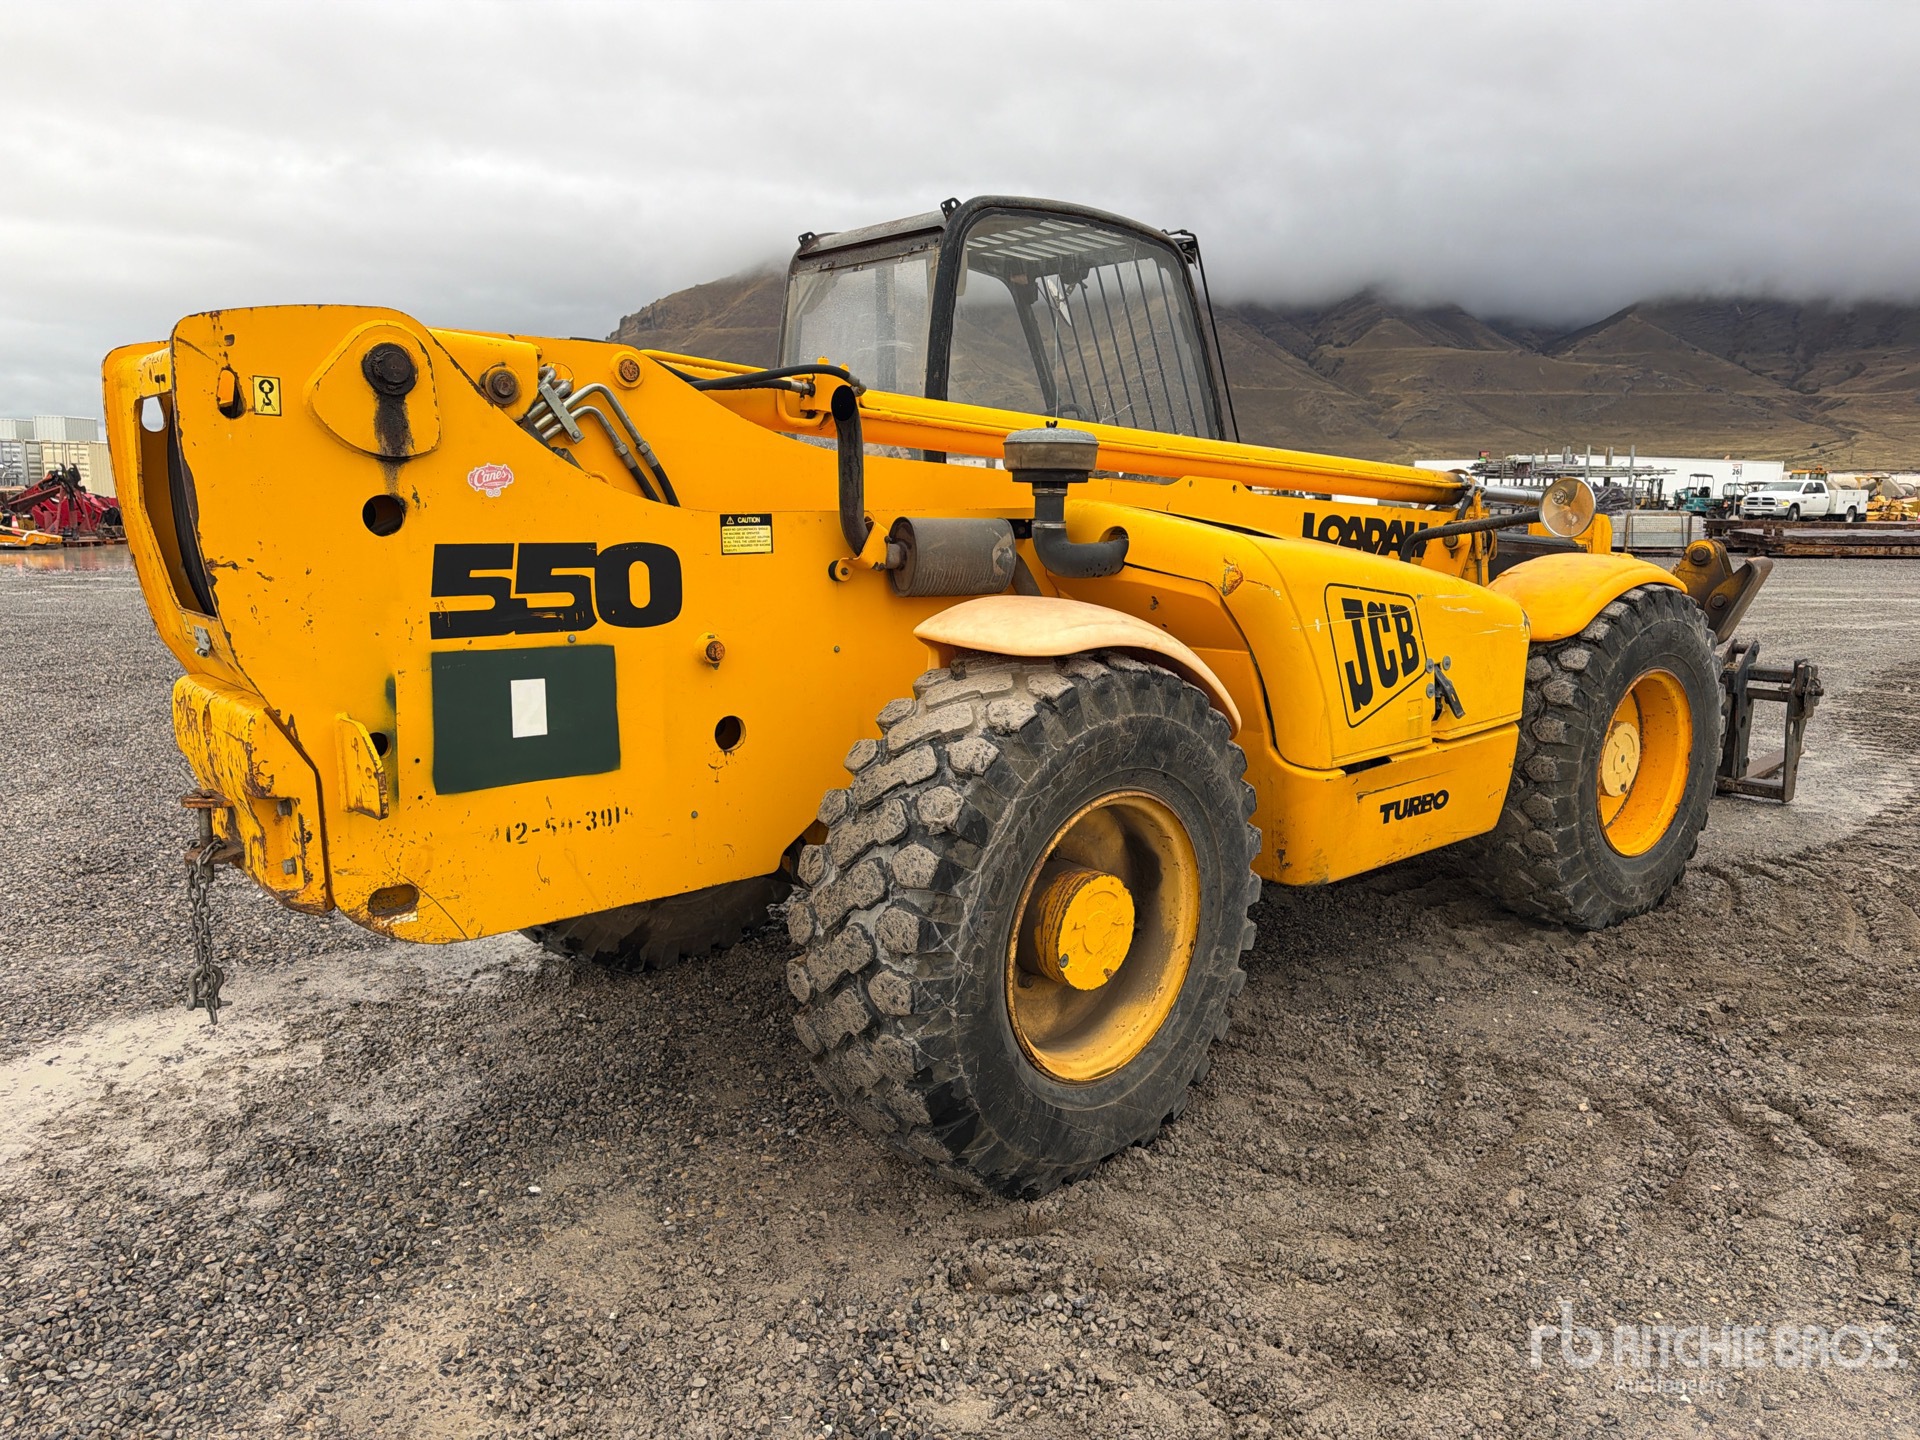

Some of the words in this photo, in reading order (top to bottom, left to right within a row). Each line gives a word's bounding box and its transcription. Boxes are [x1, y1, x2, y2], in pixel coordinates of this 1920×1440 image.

[430, 542, 682, 639] 550
[1341, 598, 1419, 712] JCB
[1380, 790, 1449, 824] TURBO
